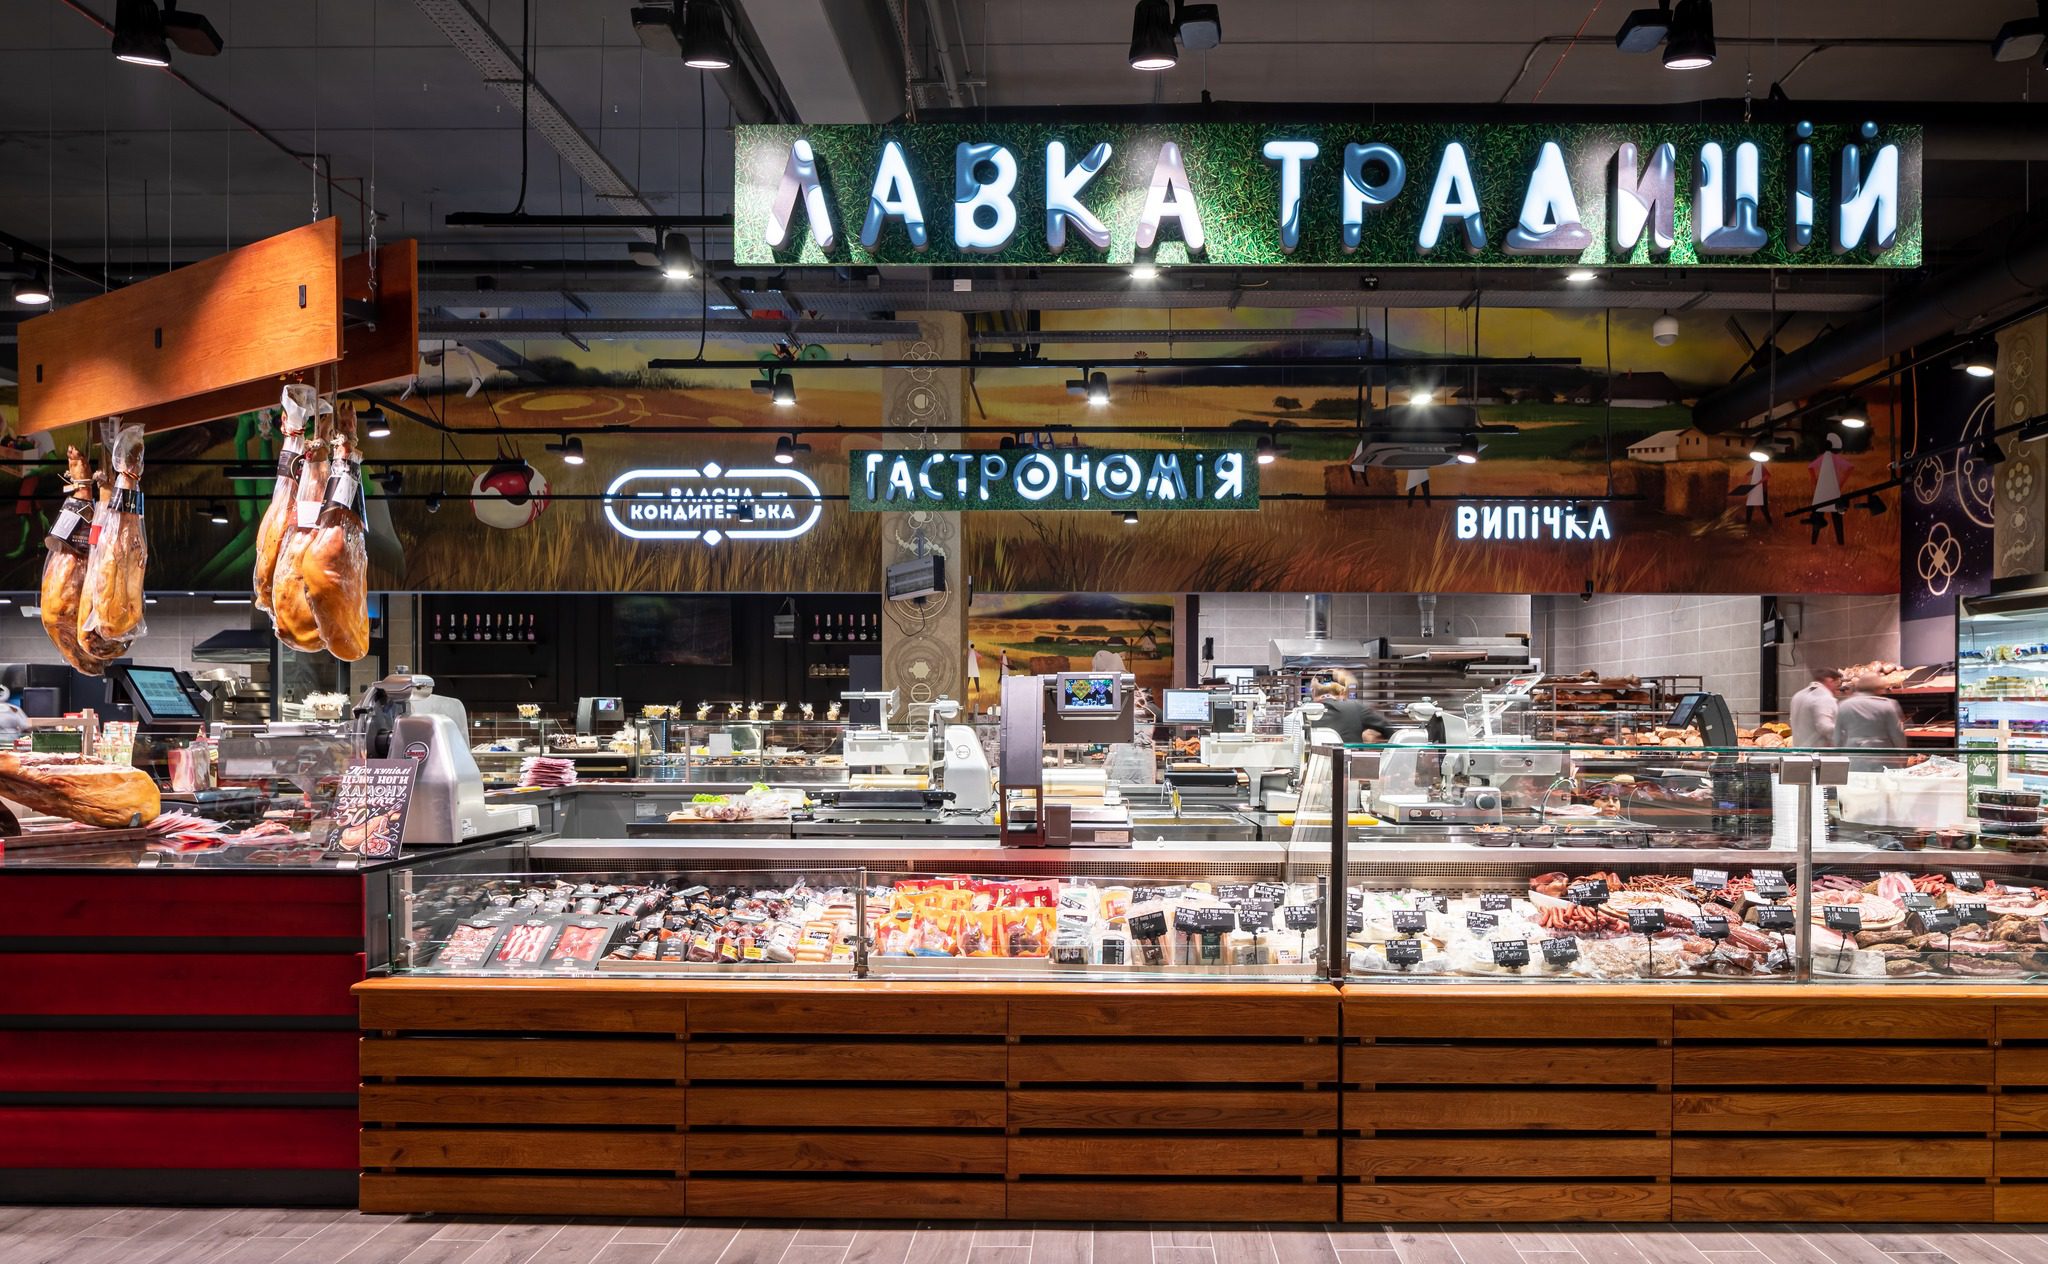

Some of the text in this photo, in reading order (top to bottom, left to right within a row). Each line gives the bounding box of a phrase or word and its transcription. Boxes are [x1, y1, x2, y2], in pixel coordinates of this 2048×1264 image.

[765, 119, 1900, 253] ЛАВКА ТРАДИЦІЙ
[630, 503, 796, 521] КОНДИТЕРЬКА
[376, 775, 410, 785] НОГИ
